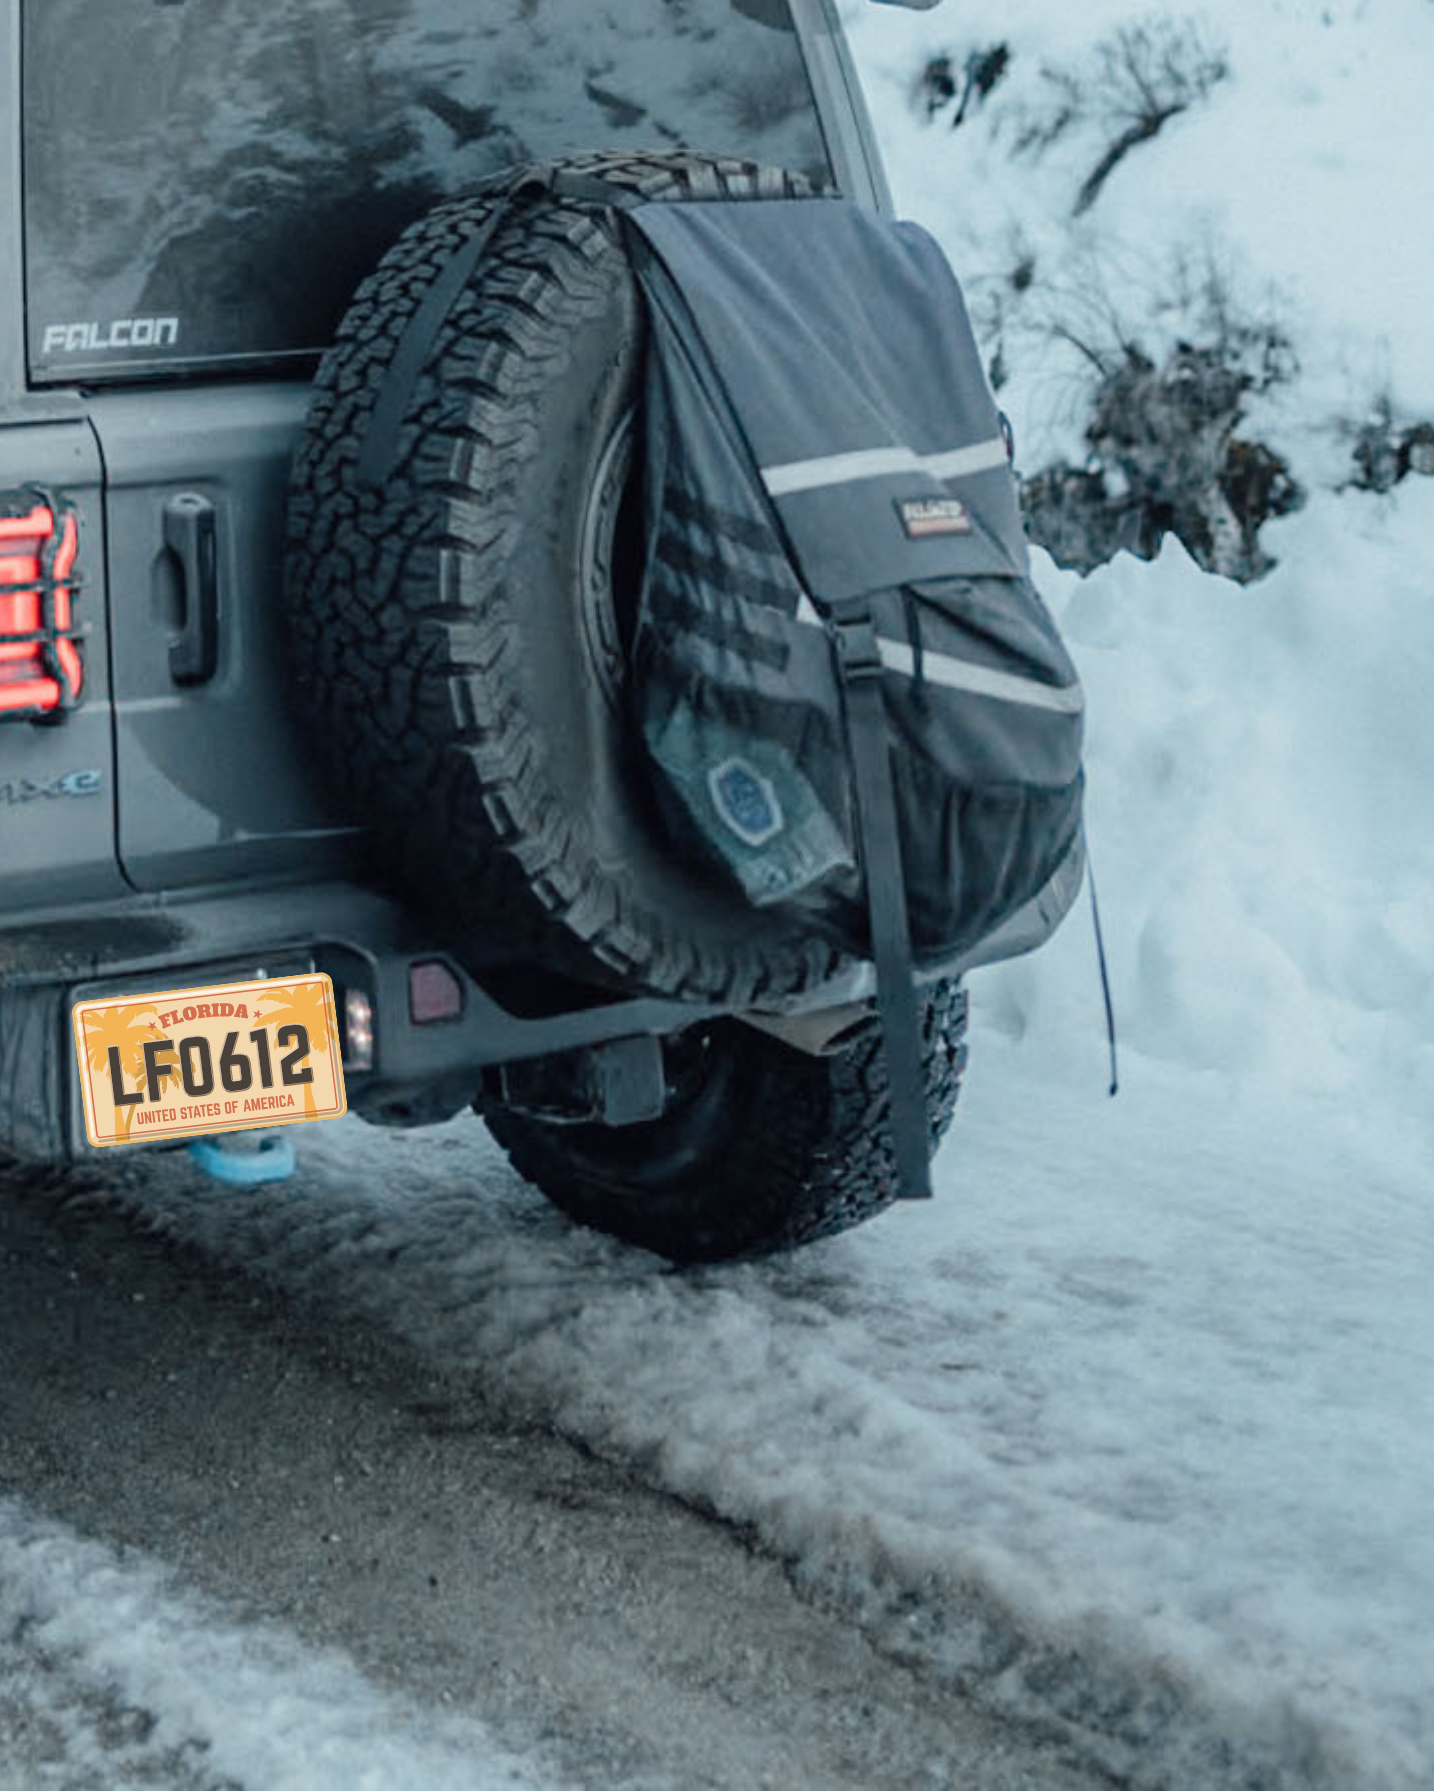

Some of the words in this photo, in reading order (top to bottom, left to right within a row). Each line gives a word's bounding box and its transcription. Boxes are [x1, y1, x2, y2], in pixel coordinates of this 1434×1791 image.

[42, 317, 179, 353] FALCON
[158, 1003, 249, 1029] FLORIDA
[107, 1023, 314, 1107] LF0612
[136, 1109, 177, 1125] UNITED
[180, 1102, 221, 1120] STATES
[224, 1100, 239, 1115] OF
[243, 1094, 296, 1113] AMERICA
